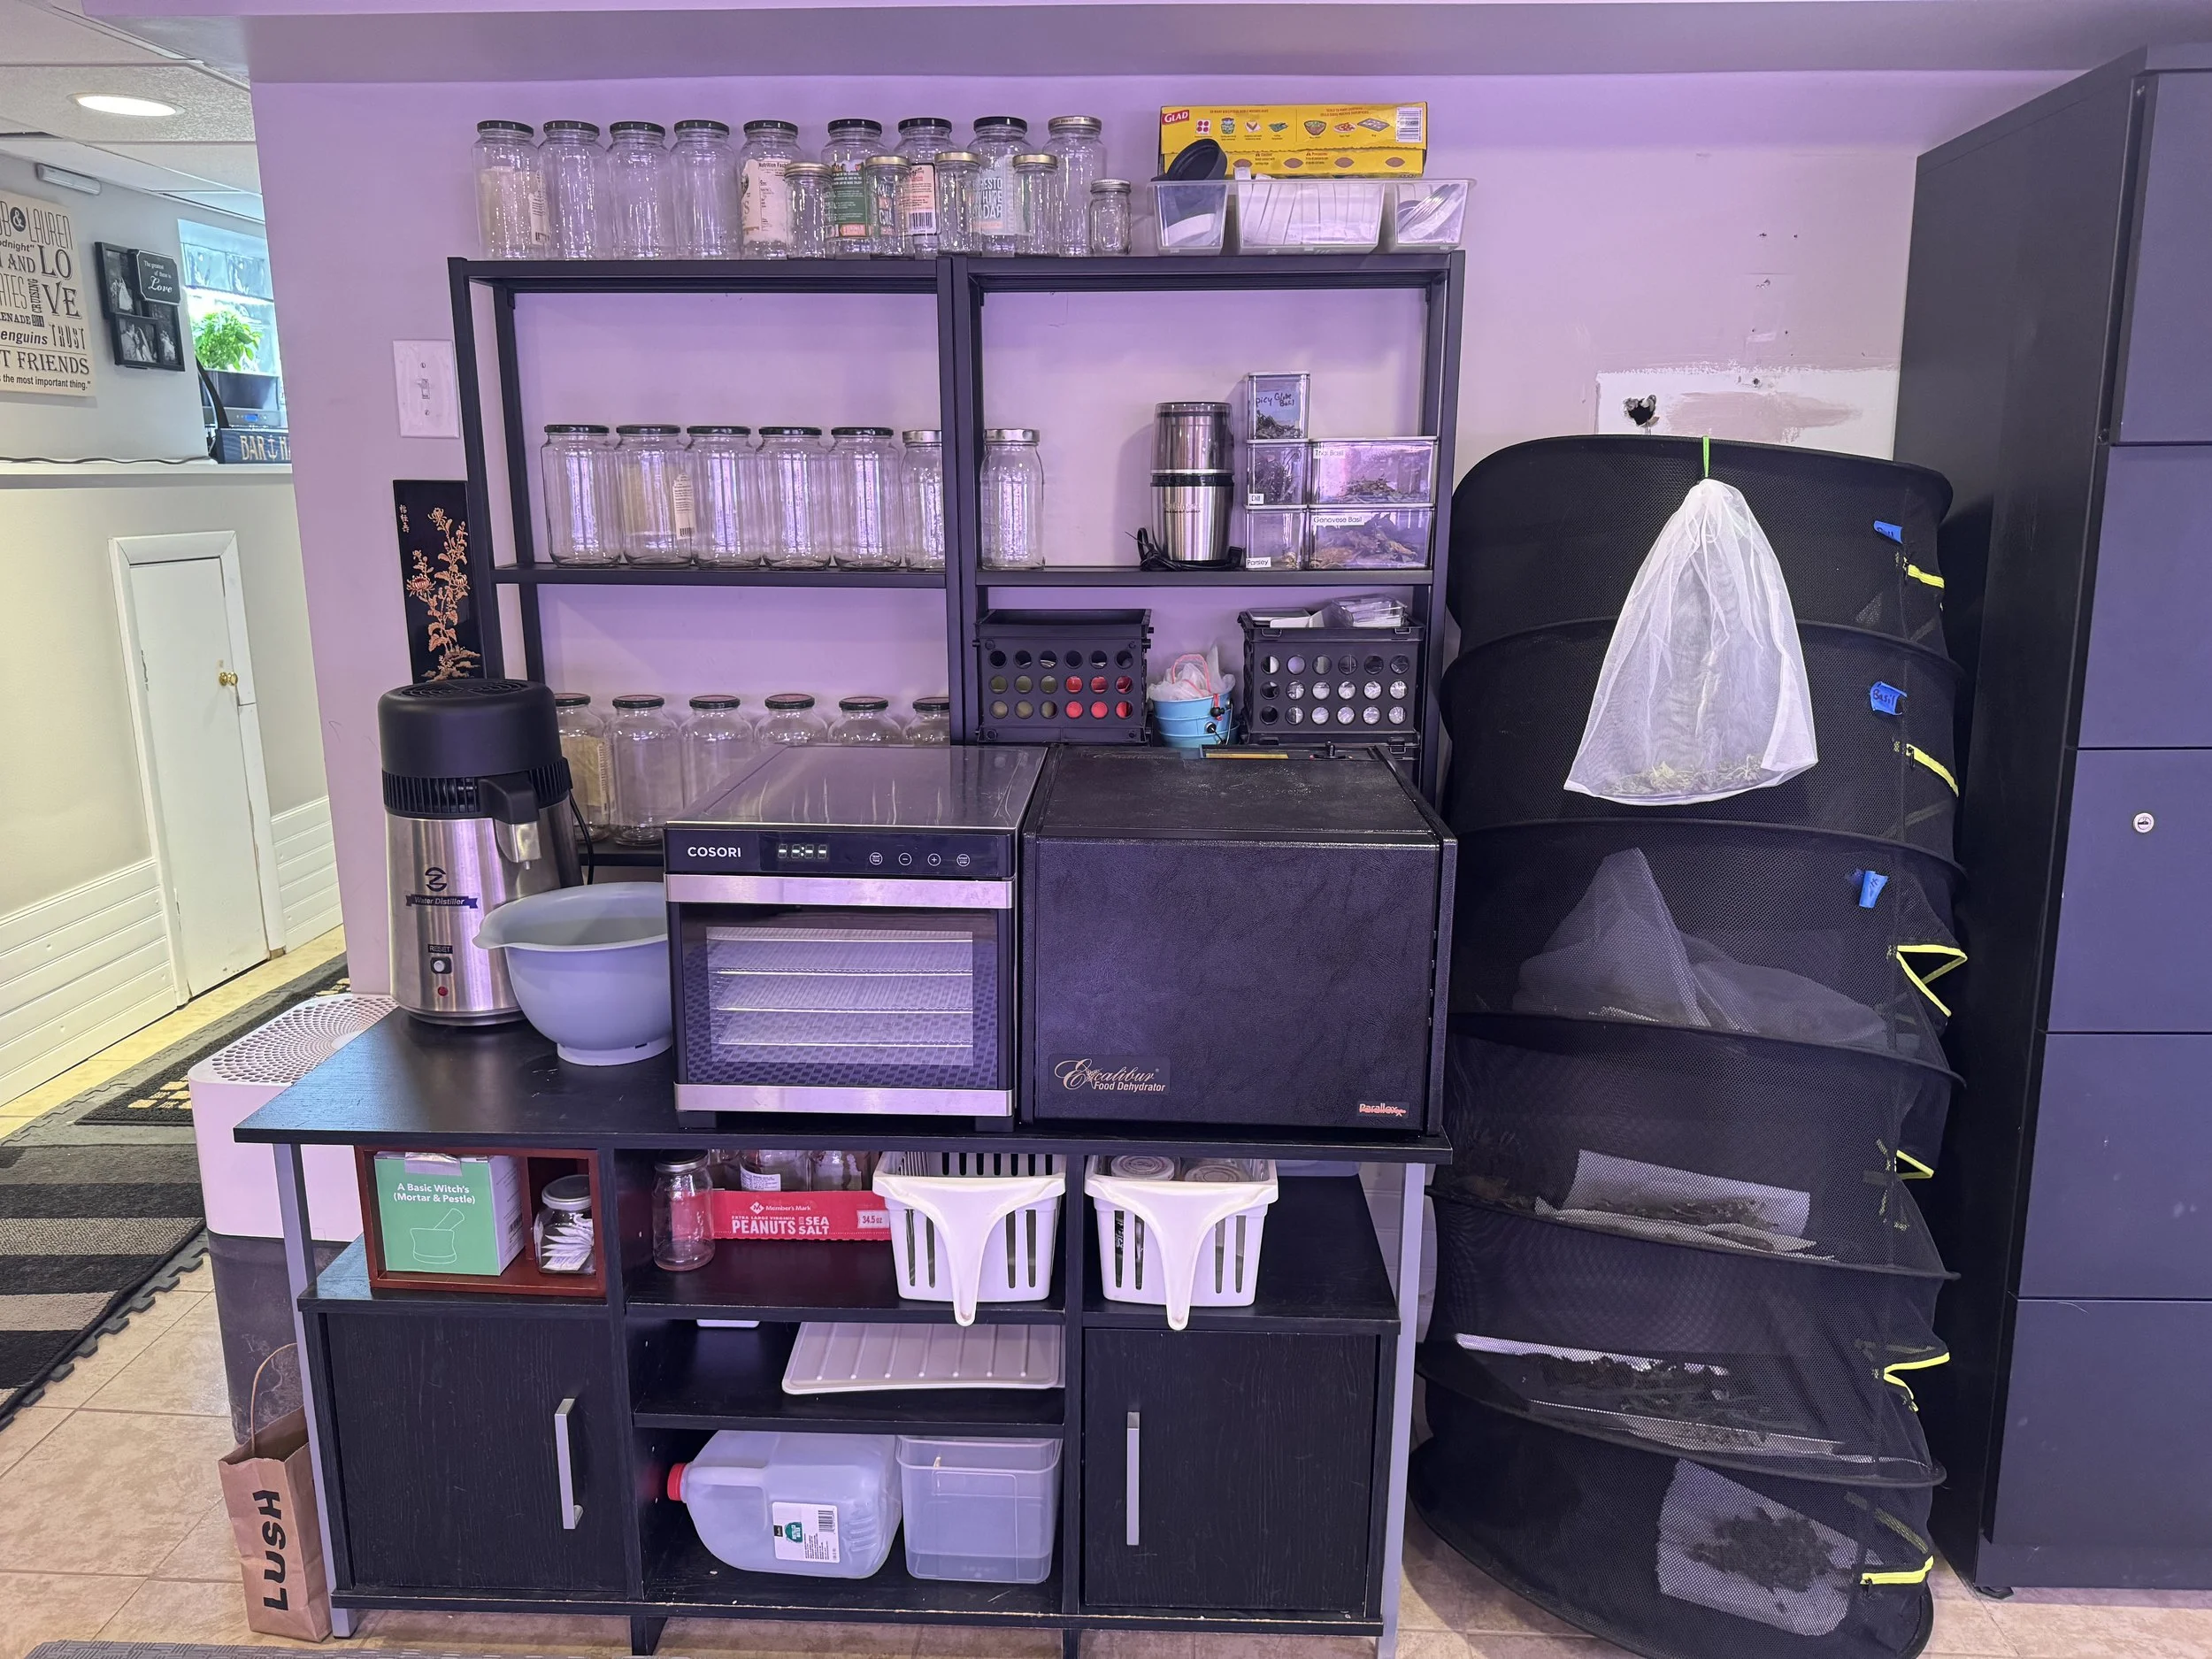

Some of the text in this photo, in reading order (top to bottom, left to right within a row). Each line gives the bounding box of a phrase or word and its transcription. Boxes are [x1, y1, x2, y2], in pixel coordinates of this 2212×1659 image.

[1164, 111, 1188, 123] GLAD
[26, 207, 73, 250] LAUREN
[8, 253, 35, 273] AND
[148, 276, 173, 293] Love
[27, 278, 42, 314] CRUISING
[0, 330, 48, 345] enguins
[49, 322, 86, 350] TRUST
[17, 351, 90, 375] FRIENDS
[3, 374, 15, 383] the
[16, 376, 34, 385] most
[35, 377, 68, 388] important
[239, 435, 267, 461] BAR
[687, 846, 741, 857] COSORI
[1094, 1081, 1166, 1093] Food Dehydrator
[397, 1183, 470, 1194] A Basic Witch's
[393, 1192, 476, 1205] (Mortar & Pestle)
[805, 1216, 830, 1225] SEA
[862, 1215, 876, 1224] 34.5
[732, 1220, 796, 1234] PEANUTS
[799, 1226, 830, 1235] SALT
[252, 1489, 289, 1611] LUSH
